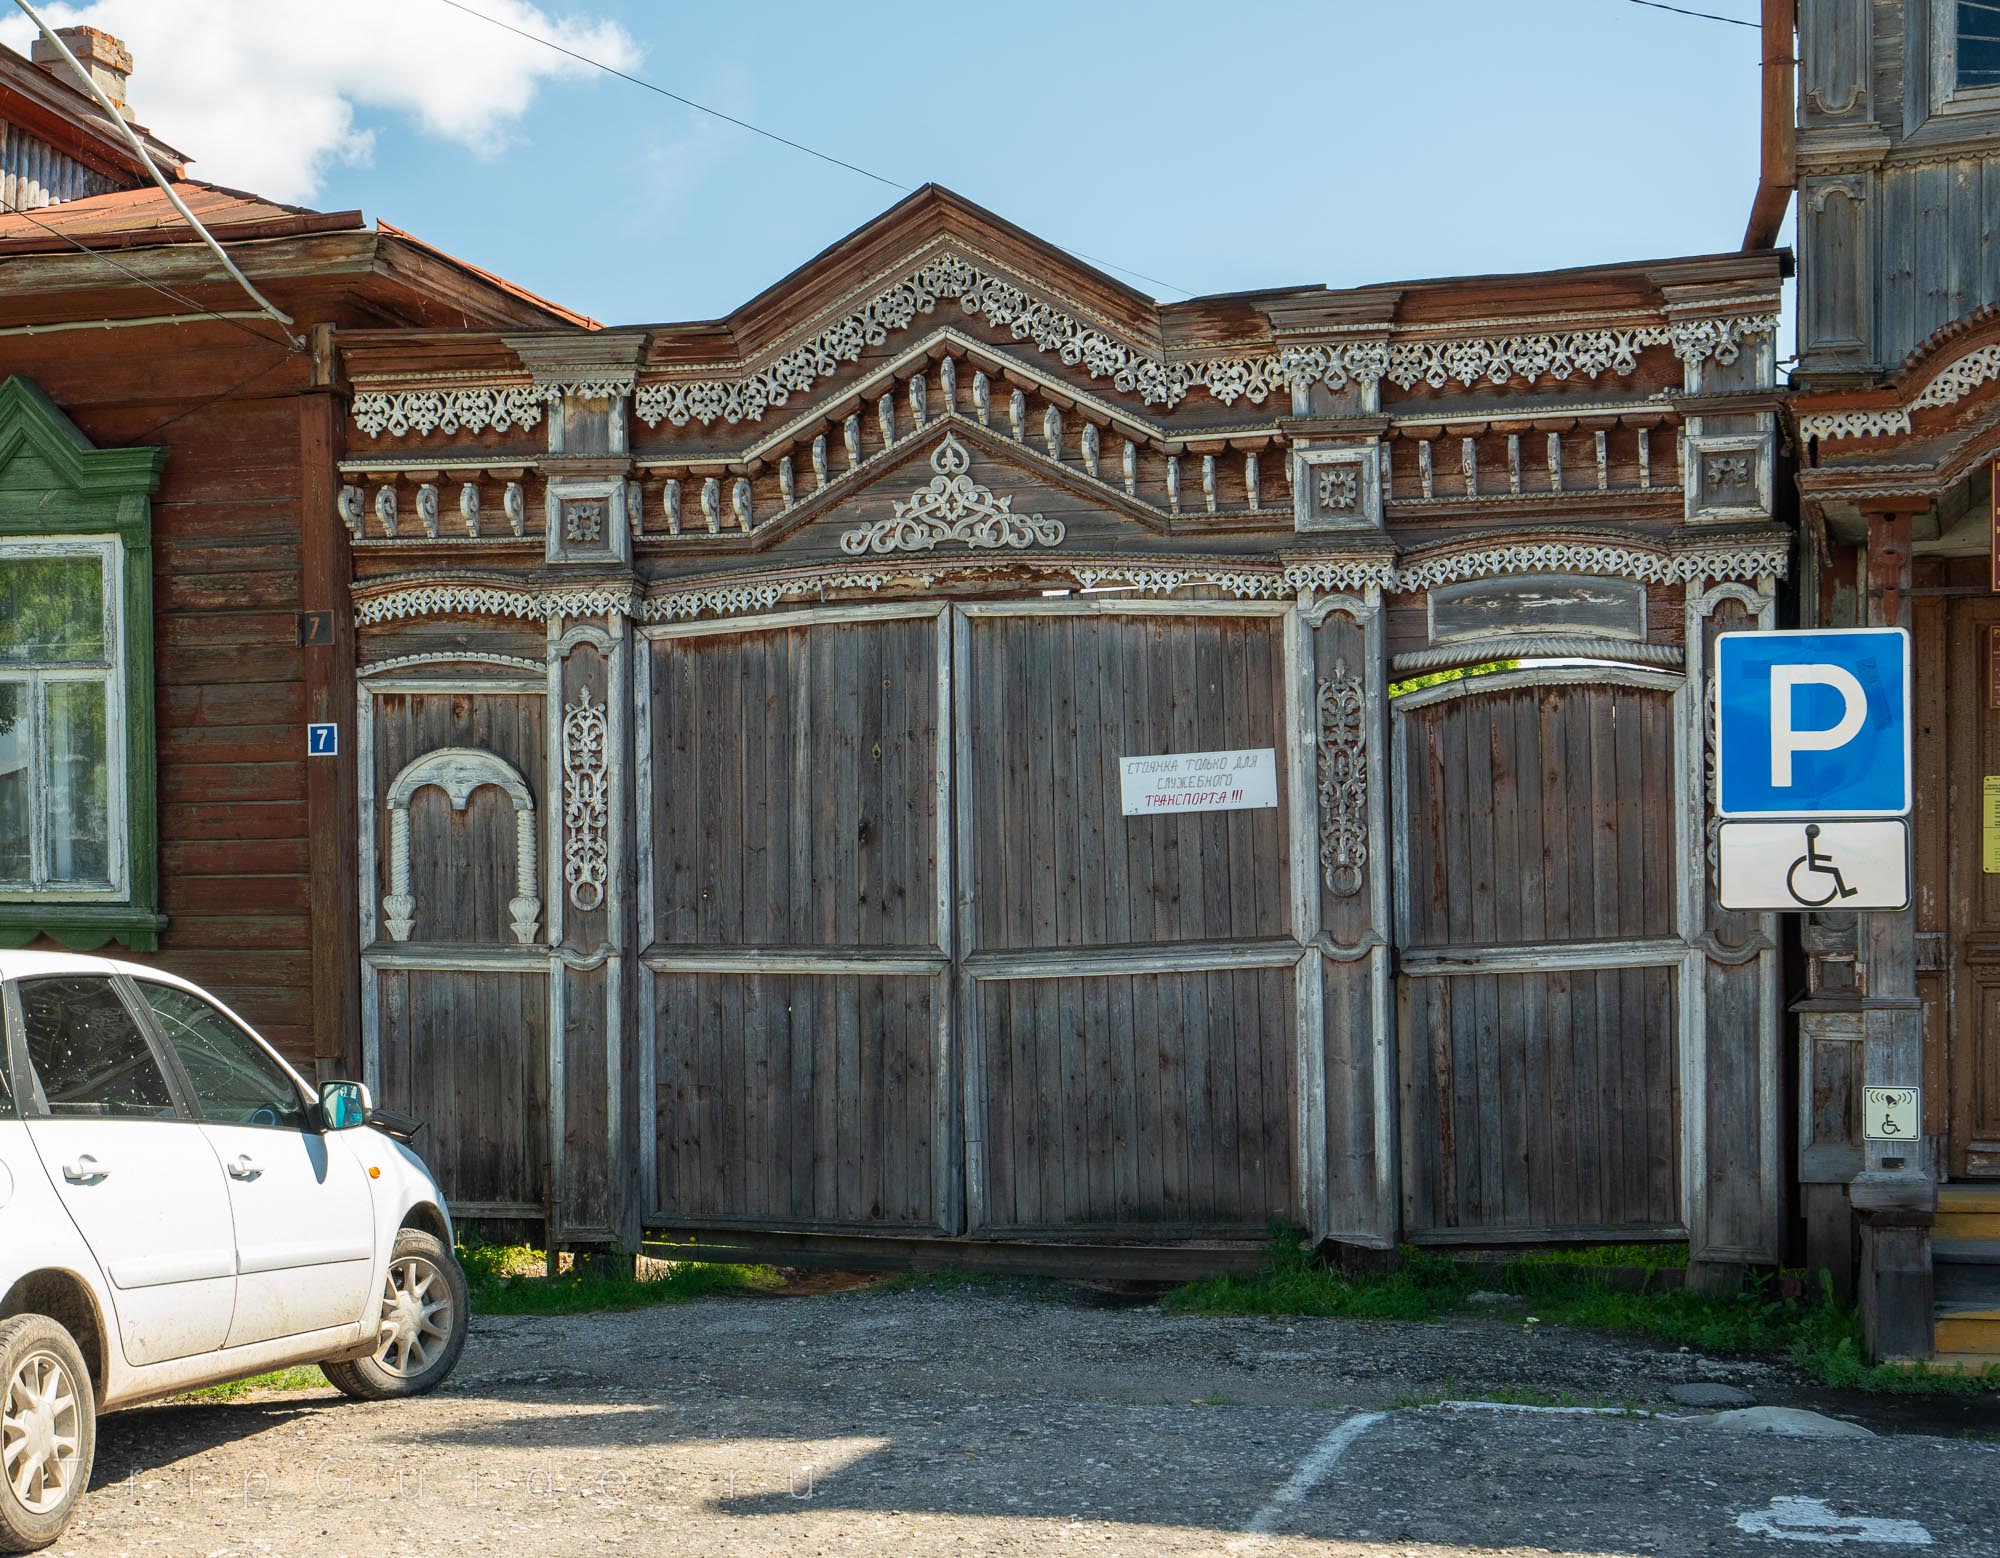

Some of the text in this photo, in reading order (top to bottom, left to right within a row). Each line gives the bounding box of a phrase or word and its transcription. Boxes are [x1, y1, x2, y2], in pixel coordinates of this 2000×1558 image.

[309, 616, 320, 640] 7
[1770, 663, 1868, 788] P
[316, 729, 328, 750] 7
[1128, 756, 1257, 774] СТОЯНКА ТОЛЬКО ДЛЯ
[1157, 774, 1232, 790] СЛУЖЕБНОГО
[1146, 791, 1227, 806] ТРАНСПОРТА
